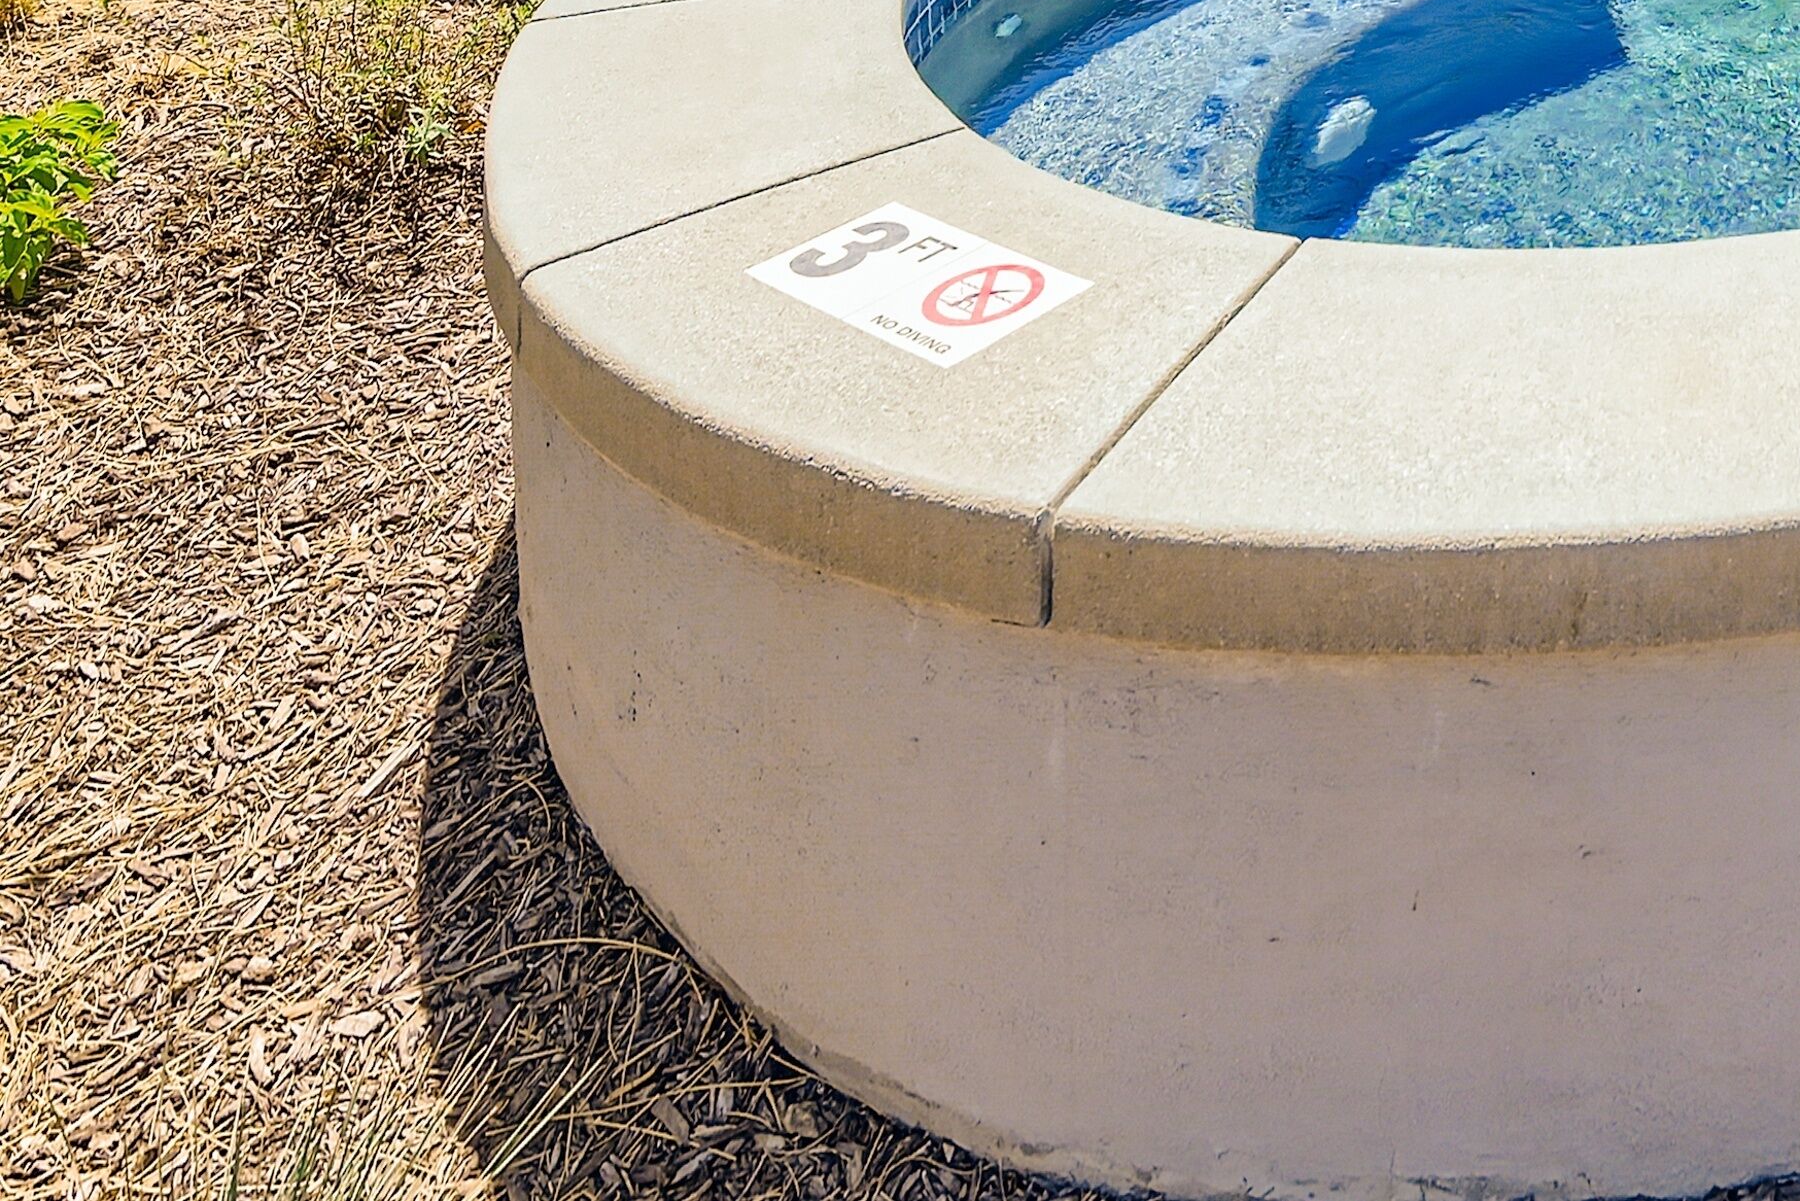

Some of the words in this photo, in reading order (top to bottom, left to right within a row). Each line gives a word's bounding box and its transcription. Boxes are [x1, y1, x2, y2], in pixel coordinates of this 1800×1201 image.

[789, 221, 910, 278] 3
[898, 236, 959, 263] FT
[870, 314, 898, 330] NO
[896, 326, 952, 355] DIVING
